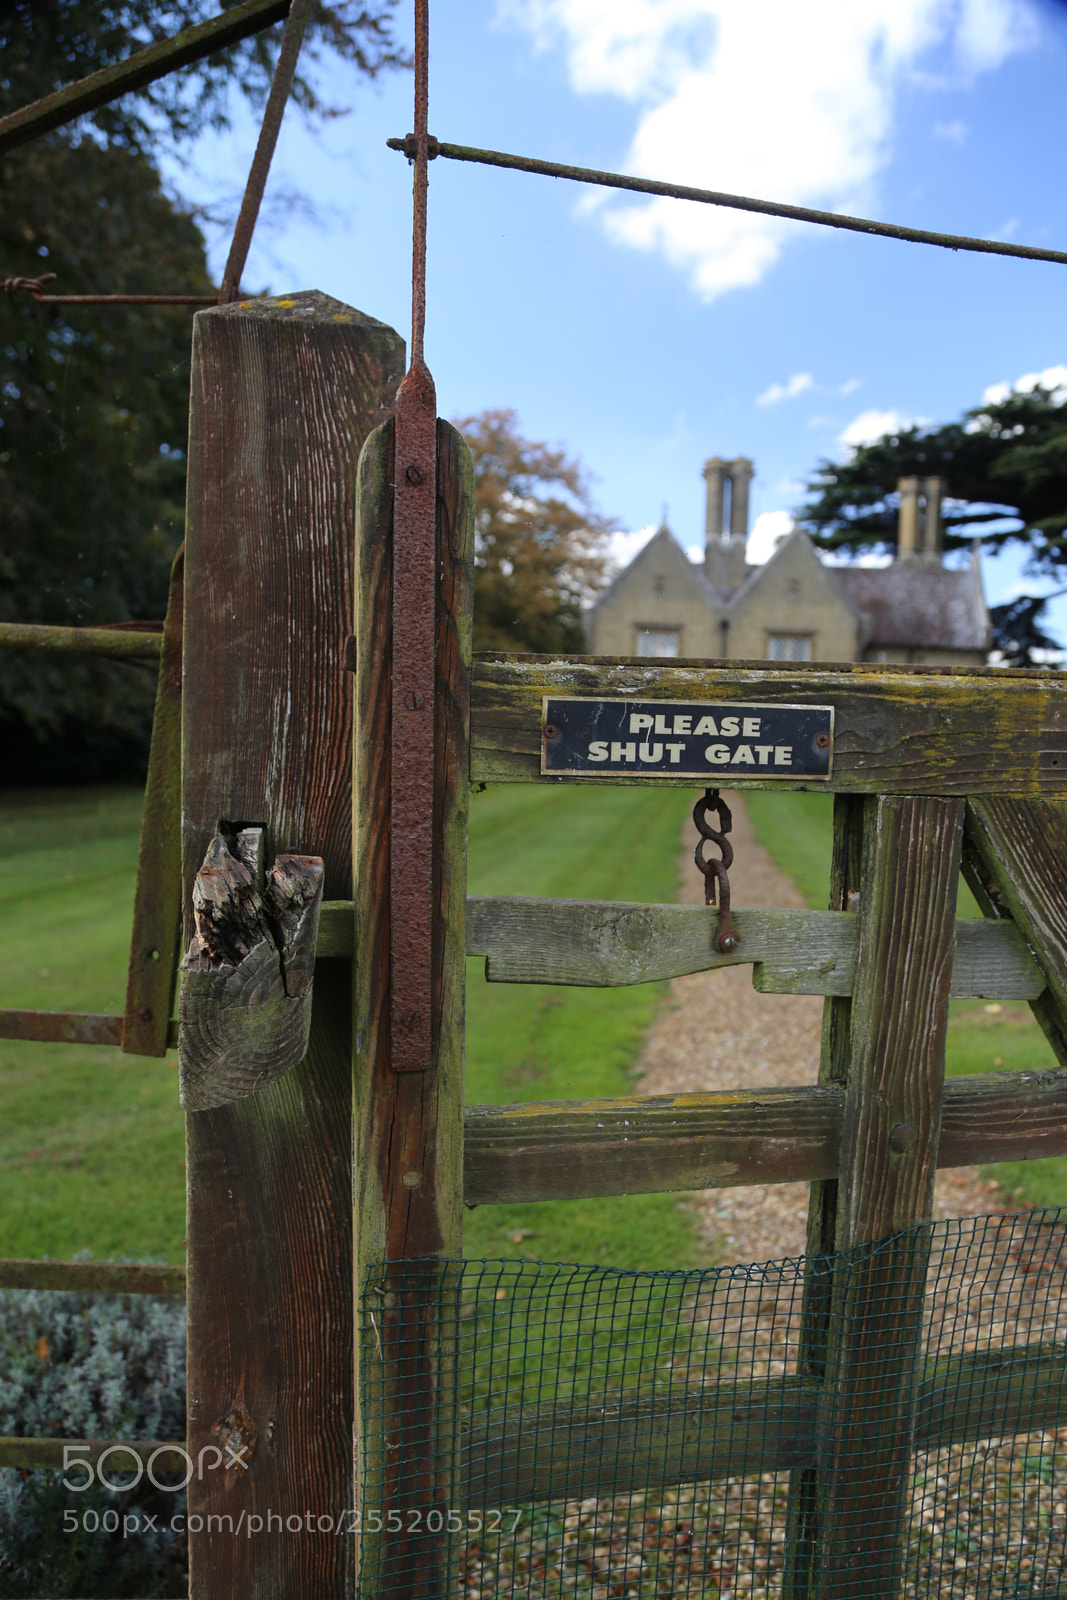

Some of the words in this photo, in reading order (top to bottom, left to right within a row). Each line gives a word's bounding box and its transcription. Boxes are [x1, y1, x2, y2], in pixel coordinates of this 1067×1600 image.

[629, 713, 761, 737] PLEASE
[587, 741, 686, 764] SHUT
[704, 743, 793, 766] GATE
